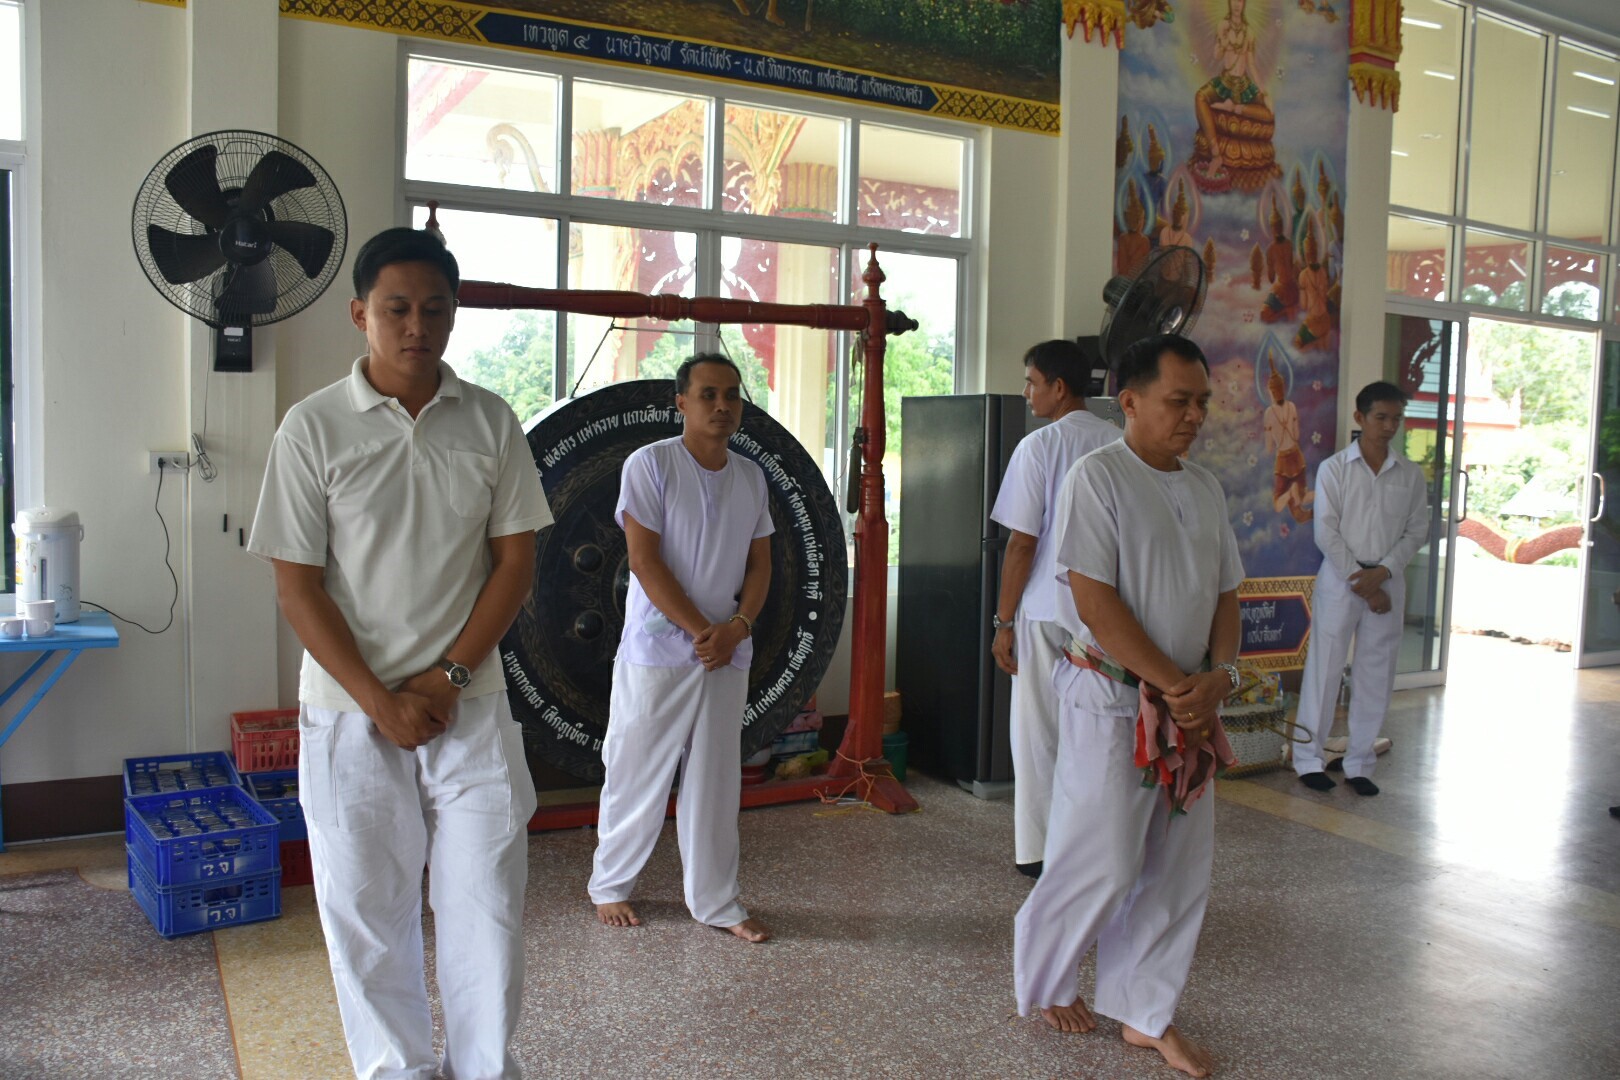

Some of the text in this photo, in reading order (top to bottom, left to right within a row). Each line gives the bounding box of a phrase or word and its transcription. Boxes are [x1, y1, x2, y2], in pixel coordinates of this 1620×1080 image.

[523, 24, 569, 51] เทวทูต
[235, 240, 257, 249] Hatari
[729, 427, 763, 456] ม่สาคร
